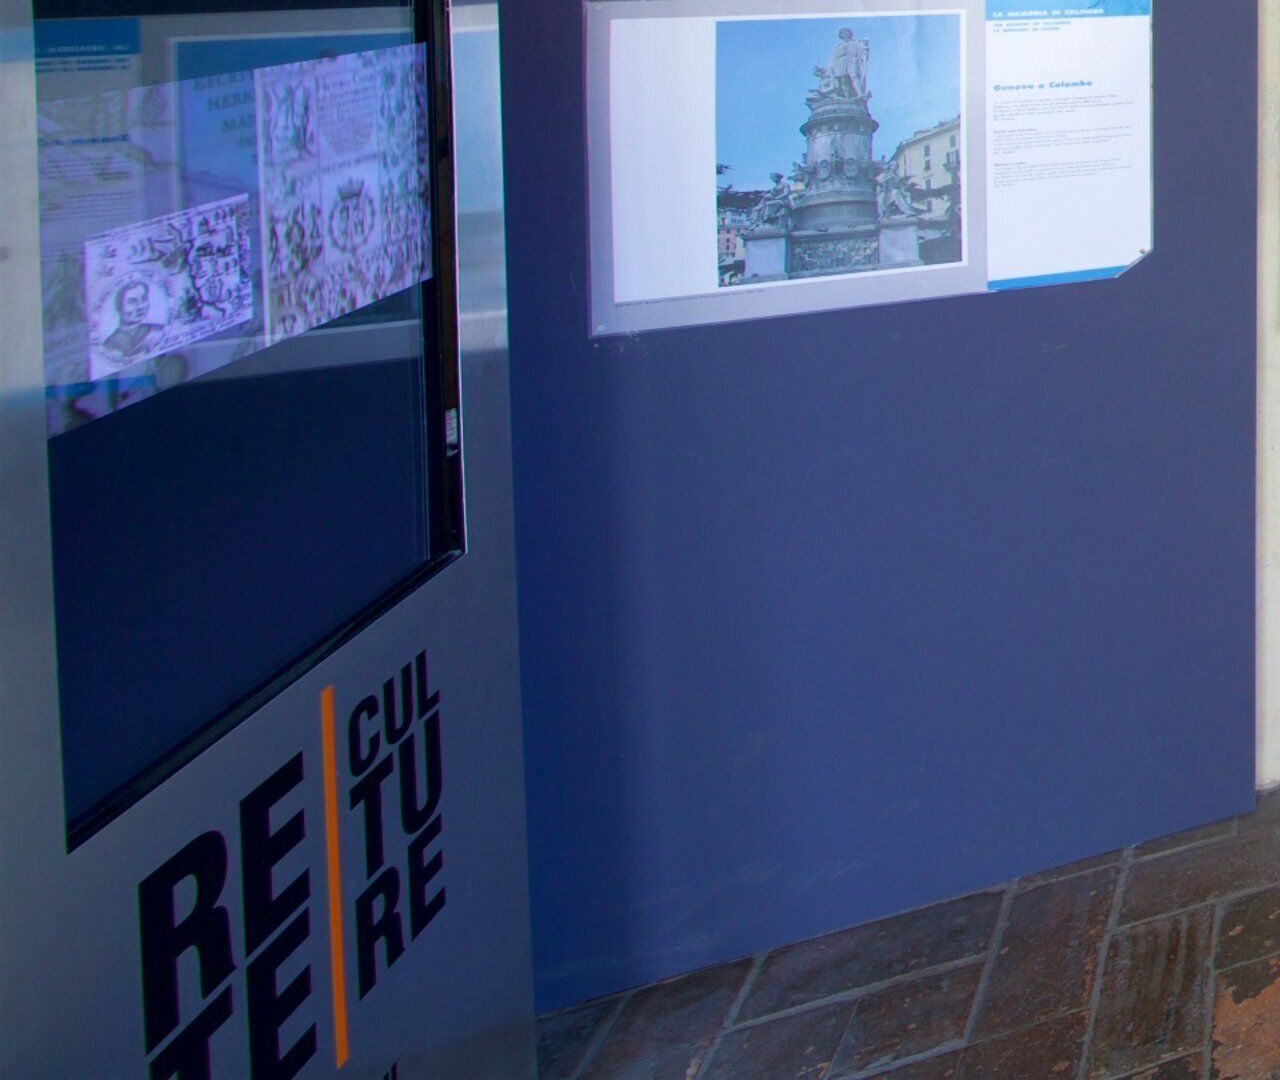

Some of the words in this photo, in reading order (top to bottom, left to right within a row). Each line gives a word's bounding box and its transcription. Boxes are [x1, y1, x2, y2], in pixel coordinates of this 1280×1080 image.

[347, 648, 440, 778] CUL
[349, 708, 442, 880] TU
[138, 750, 311, 1057] RE
[354, 813, 446, 1002] RE
